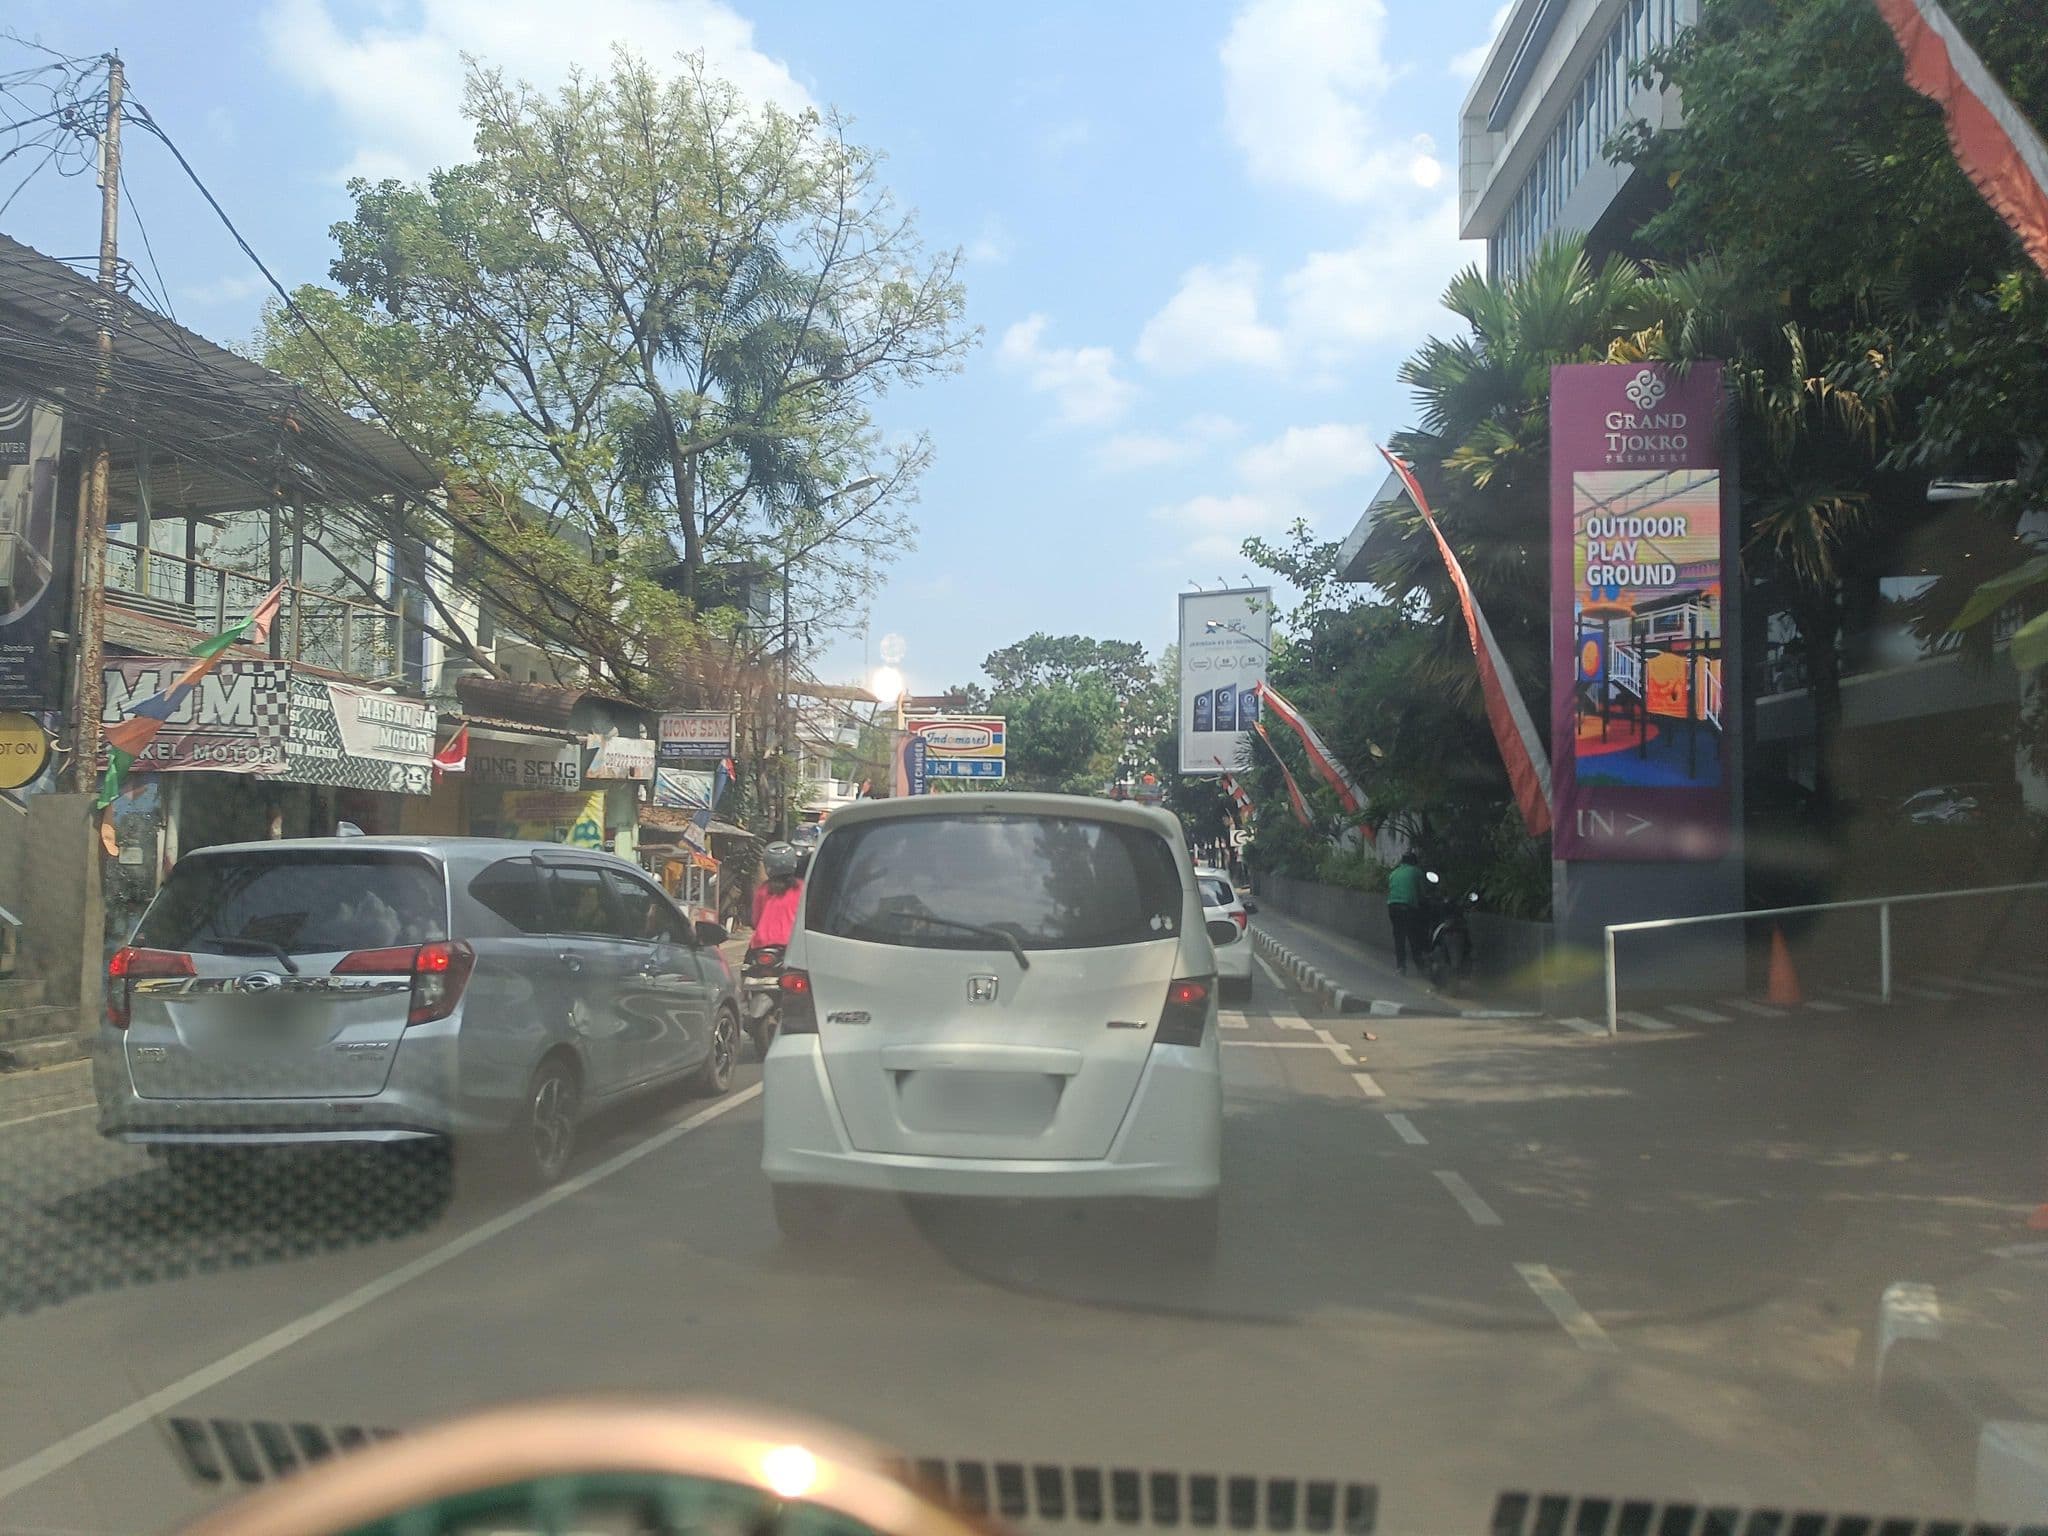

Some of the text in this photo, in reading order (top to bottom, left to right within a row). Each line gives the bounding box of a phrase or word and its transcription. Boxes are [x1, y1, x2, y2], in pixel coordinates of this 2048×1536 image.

[1605, 411, 1687, 430] GRAND
[1604, 432, 1688, 455] TJOKRO
[1586, 516, 1687, 538] OUTDOOR
[1587, 541, 1638, 561] PLAY
[1586, 564, 1677, 586] GROUND
[358, 697, 412, 725] MAISAN
[663, 719, 730, 737] LIONG SENG
[927, 732, 987, 744] Indomaret
[16, 743, 38, 754] ON
[380, 727, 427, 752] MOTOR
[193, 743, 278, 764] MOTOR
[523, 759, 577, 779] SENG
[1577, 809, 1614, 837] IN
